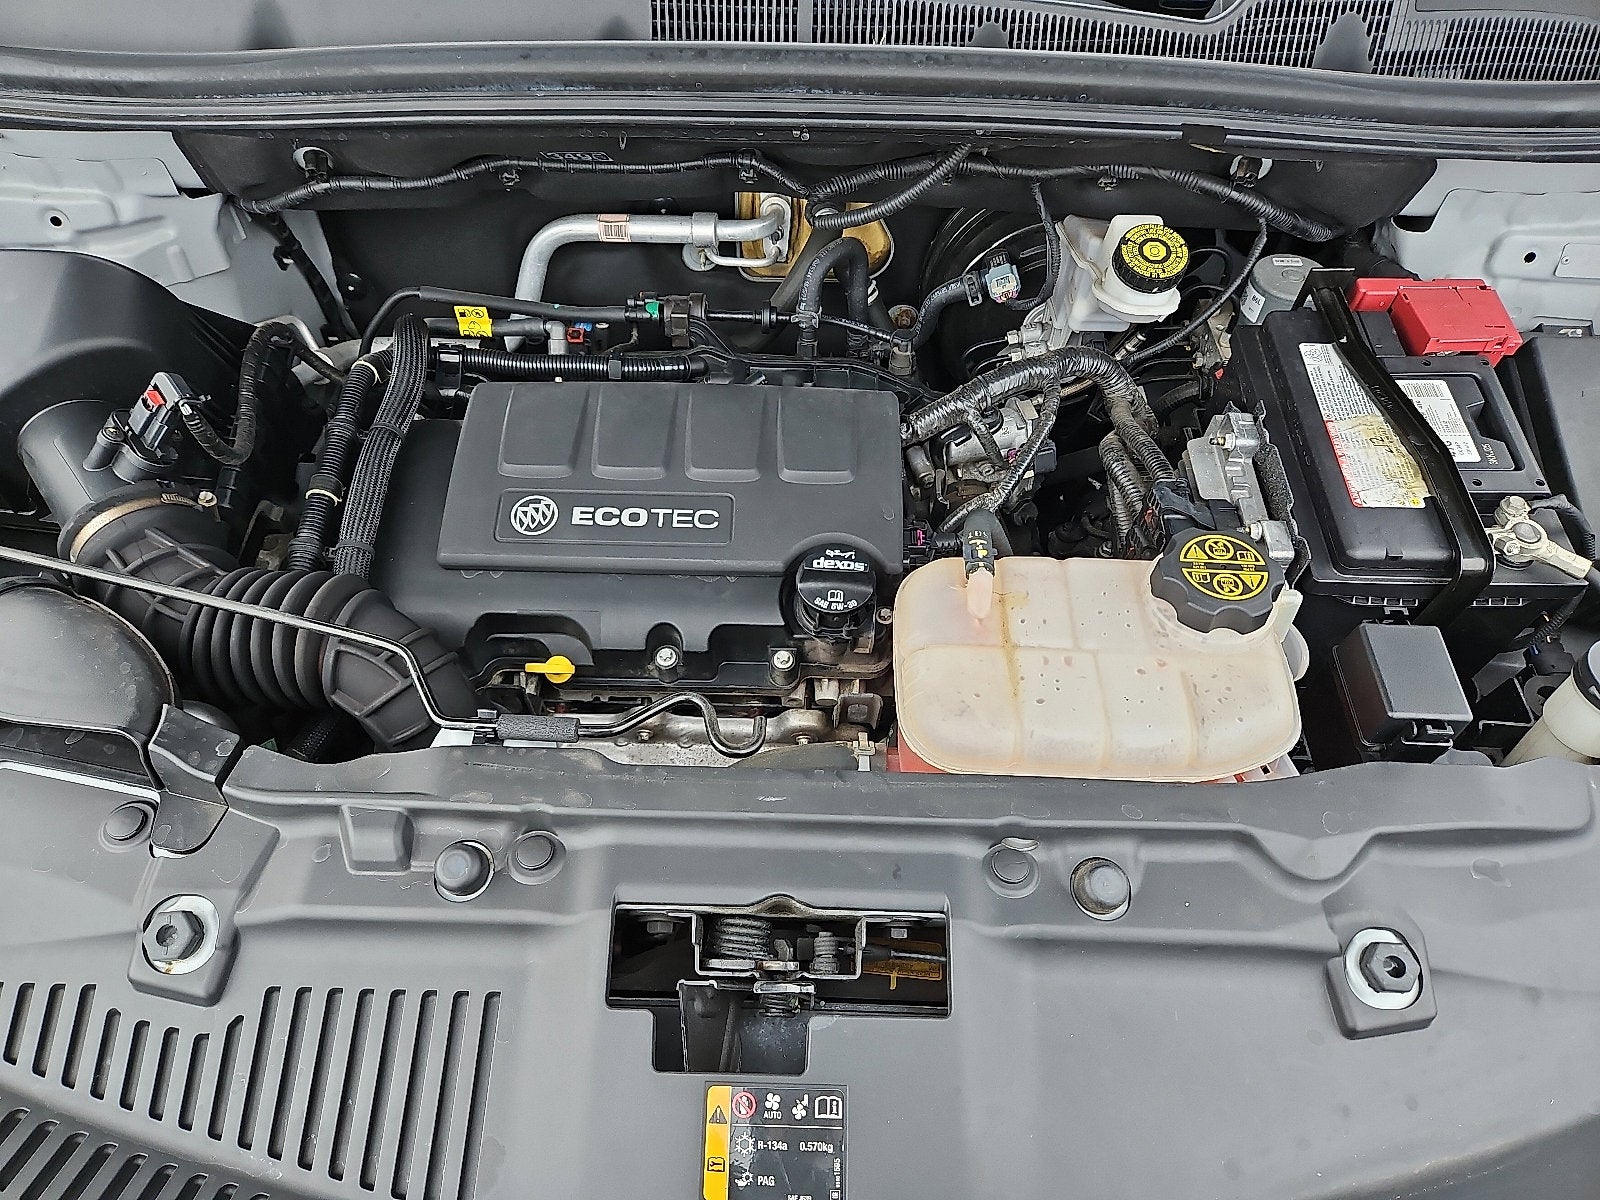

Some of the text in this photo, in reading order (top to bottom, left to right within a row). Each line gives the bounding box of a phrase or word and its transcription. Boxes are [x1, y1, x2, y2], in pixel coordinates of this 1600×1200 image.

[571, 506, 720, 529] ECOTEC
[812, 556, 865, 571] dexos
[763, 1110, 782, 1119] AUTO
[757, 1140, 834, 1154] R-134a 0.570kg
[757, 1176, 775, 1186] PAG
